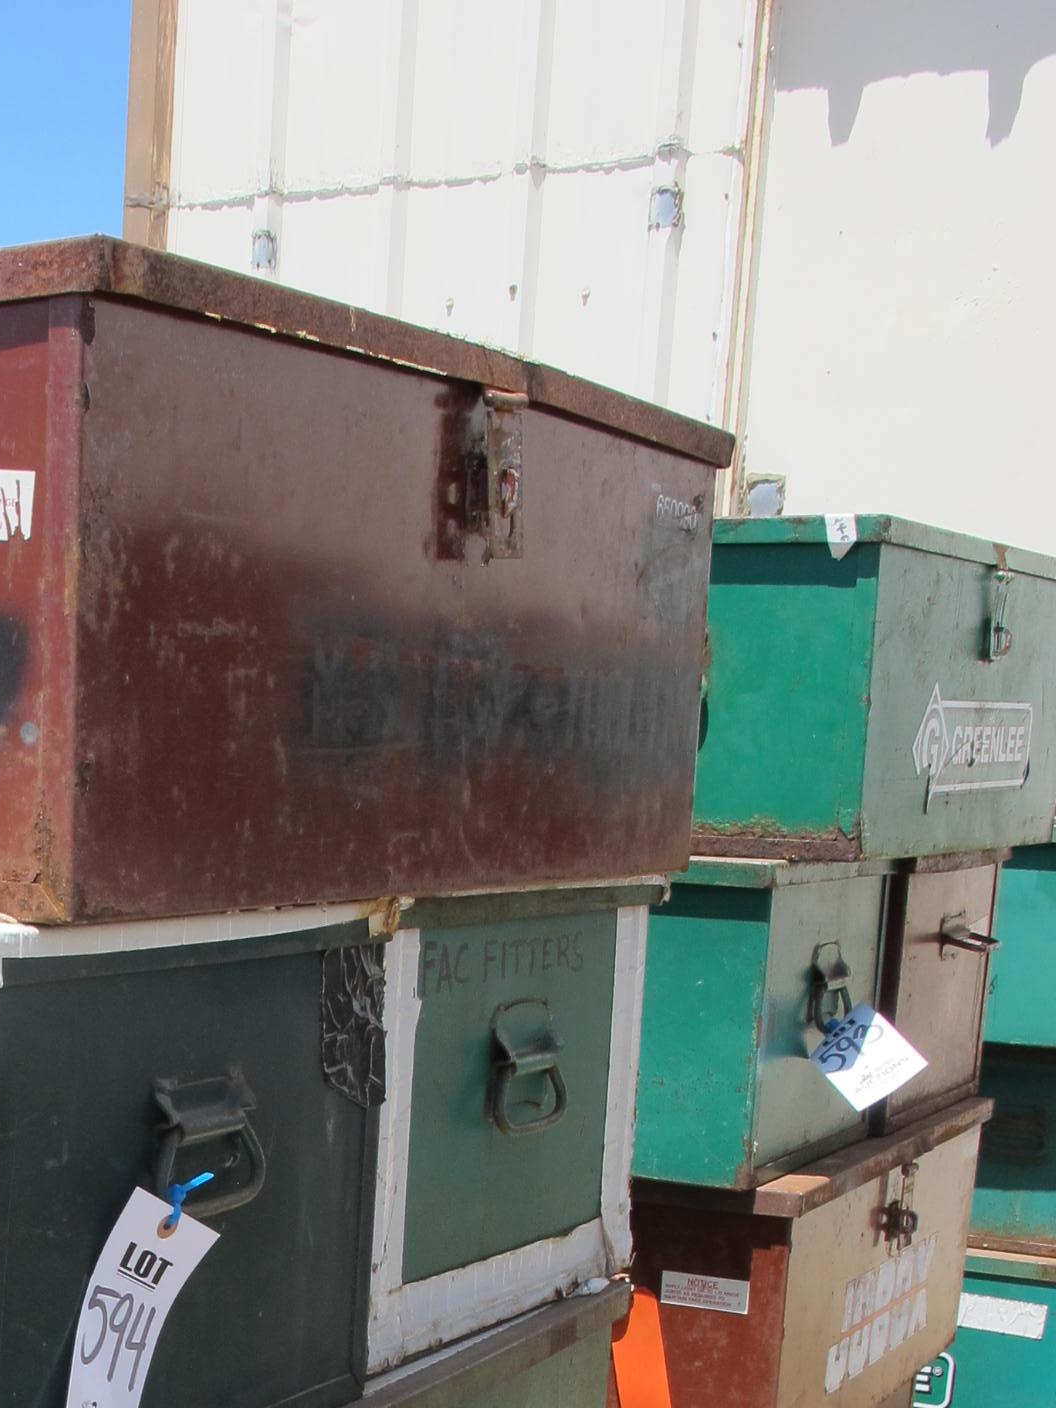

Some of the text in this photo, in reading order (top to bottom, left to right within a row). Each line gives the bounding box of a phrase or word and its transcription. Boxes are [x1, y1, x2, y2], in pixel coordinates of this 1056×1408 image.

[951, 725, 1025, 765] GREENLEE
[482, 931, 584, 983] FITTERS
[119, 1241, 174, 1285] LOT
[687, 1278, 719, 1289] NOTICE
[80, 1285, 156, 1392] 594
